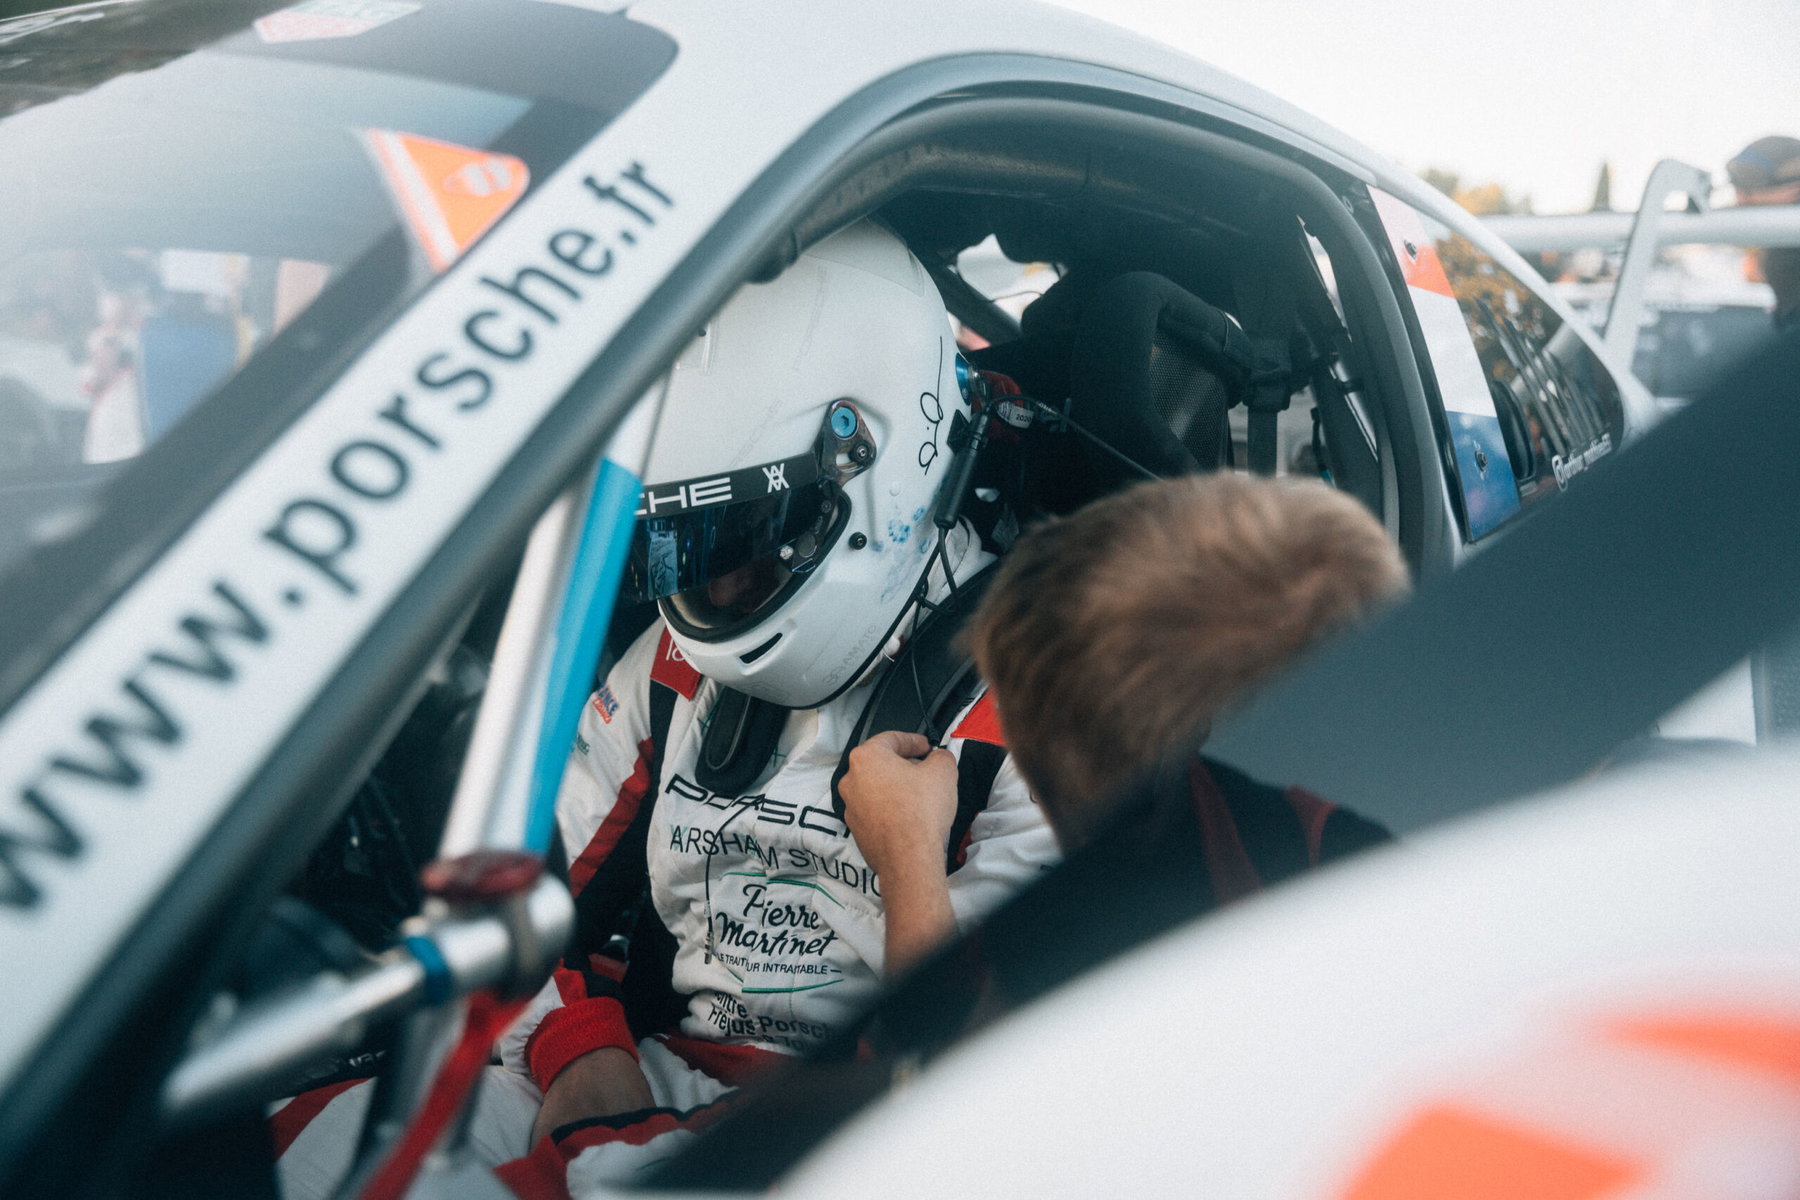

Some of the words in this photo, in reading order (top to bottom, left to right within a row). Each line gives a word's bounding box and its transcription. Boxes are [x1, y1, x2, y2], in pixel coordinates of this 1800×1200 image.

[0, 161, 674, 914] www.porsche.fr
[670, 824, 779, 870] ARSHAM
[743, 883, 820, 930] Pierre
[715, 911, 839, 957] Martinet
[725, 953, 760, 972] TRAITUR
[757, 1015, 828, 1040] Porsc
